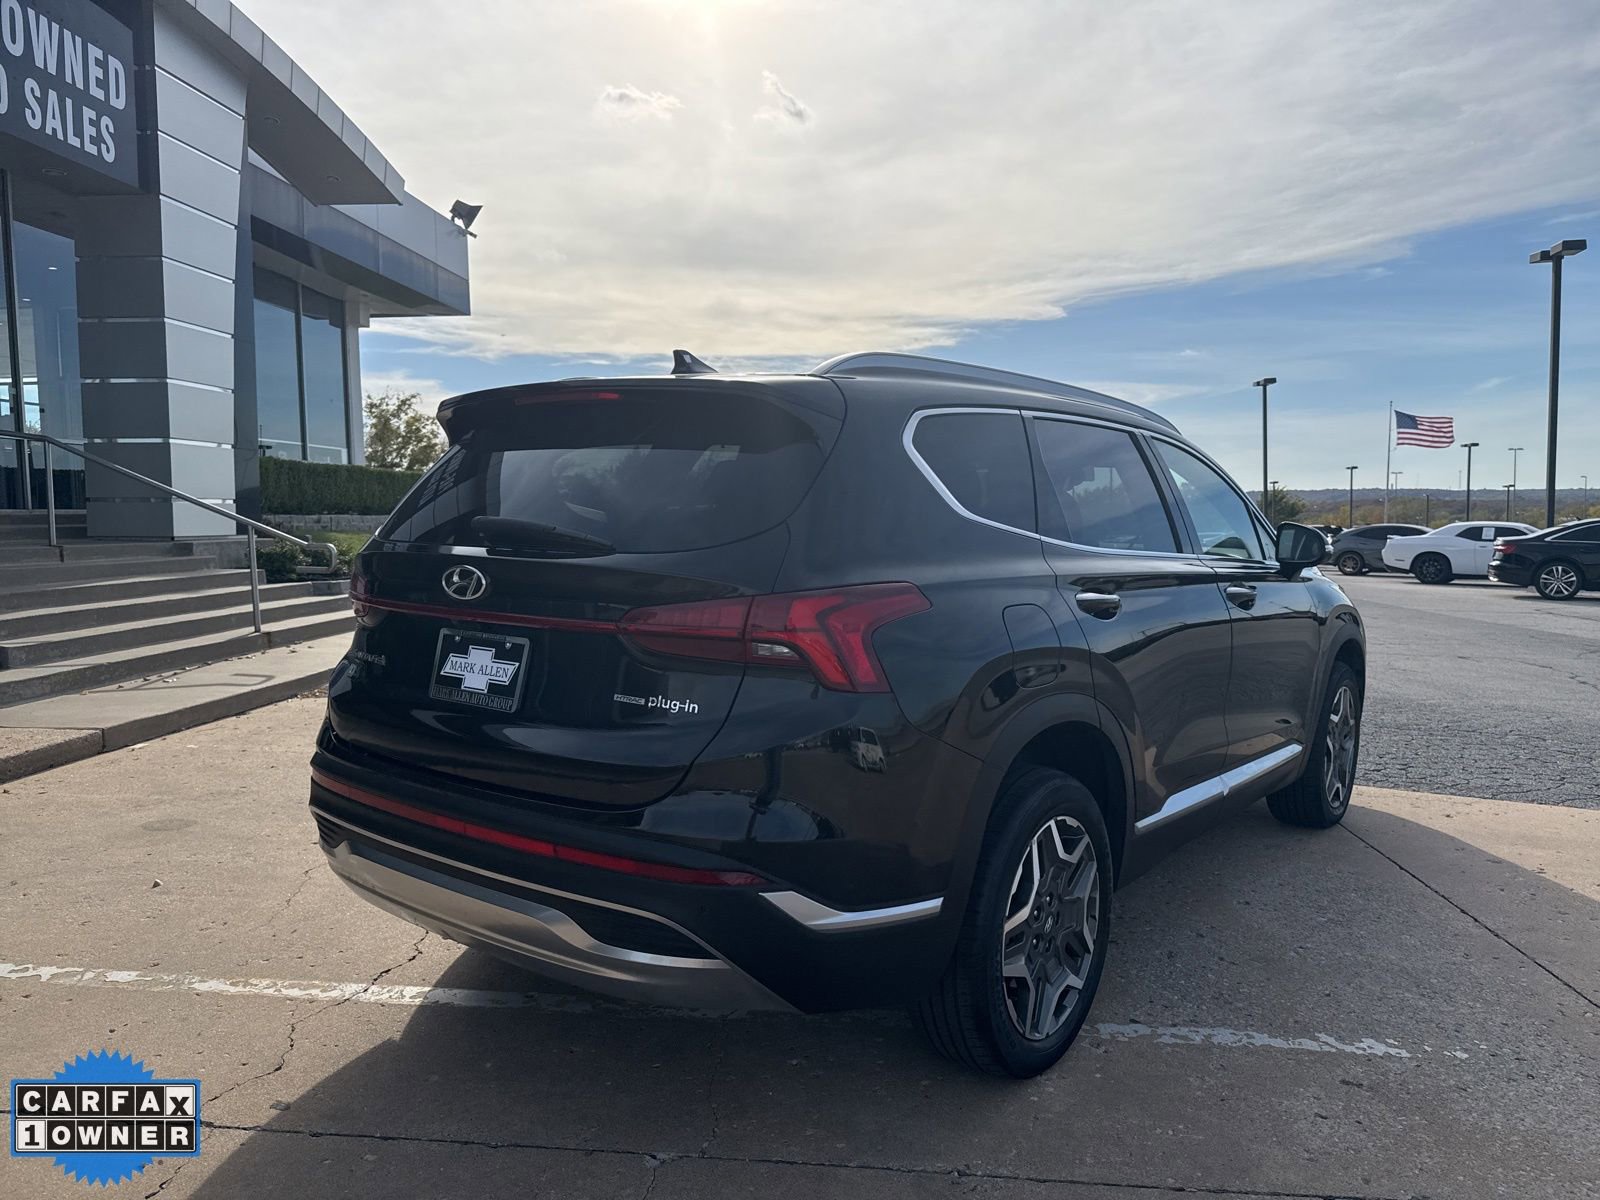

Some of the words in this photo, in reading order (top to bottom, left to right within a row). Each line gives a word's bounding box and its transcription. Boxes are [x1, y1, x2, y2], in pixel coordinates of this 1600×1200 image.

[0, 0, 126, 110] OWNED
[24, 77, 116, 163] SALES
[448, 659, 476, 674] MARK
[477, 664, 510, 679] ALLEN
[451, 689, 470, 702] ALLEN
[470, 693, 489, 706] AUTO
[489, 697, 514, 711] GROUP
[648, 695, 699, 714] plug-in
